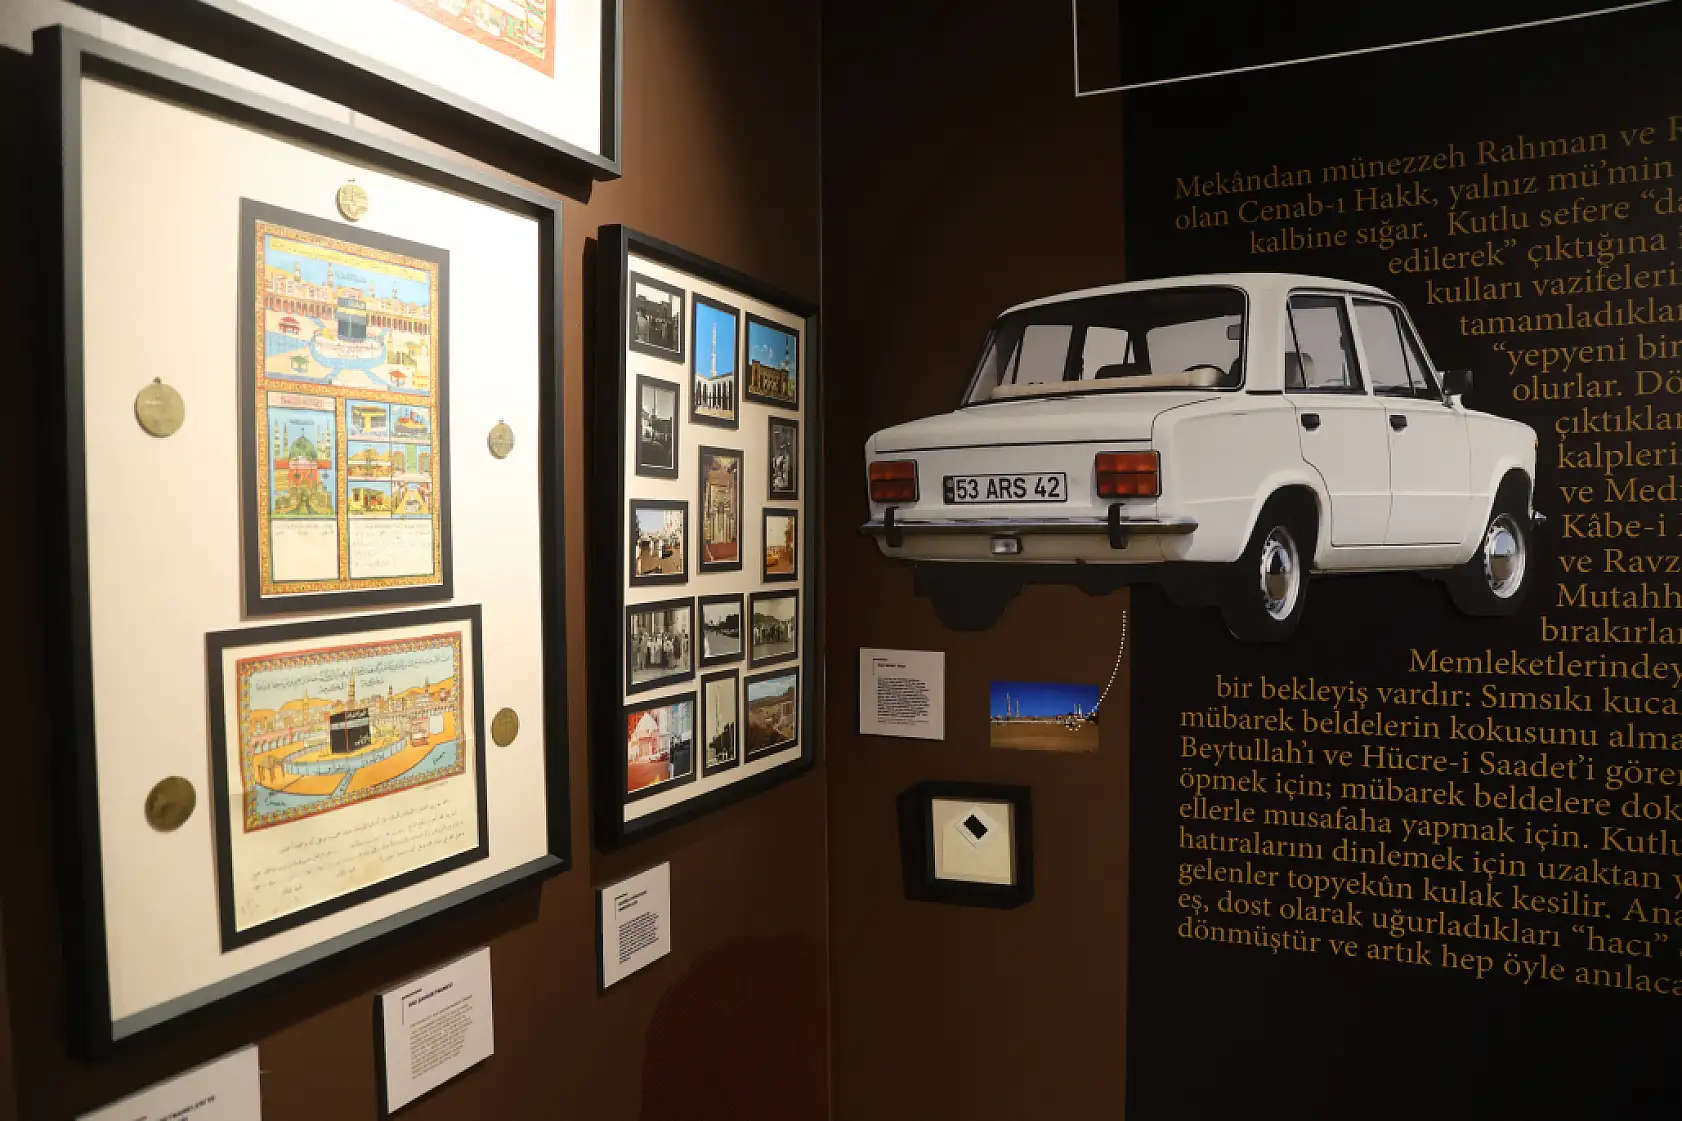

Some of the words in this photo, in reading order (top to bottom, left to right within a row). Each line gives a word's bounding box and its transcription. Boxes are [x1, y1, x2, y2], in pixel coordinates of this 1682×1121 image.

[1176, 165, 1311, 199] Mekândan
[1323, 144, 1465, 182] münezzeh
[1479, 134, 1607, 164] Rahman
[1620, 128, 1654, 146] ve
[1176, 206, 1228, 229] olan
[1239, 193, 1344, 222] Cenab-ı
[1354, 181, 1438, 211] Hakk,
[1449, 173, 1537, 209] yalnız
[1251, 227, 1347, 254] kalbine
[1356, 219, 1427, 250] sığar.
[1448, 206, 1529, 235] Kutlu
[1540, 198, 1630, 227] sefere
[1528, 232, 1666, 271] çıktığına
[1427, 276, 1522, 304] kulları
[1532, 262, 1682, 296] vazifeleri
[1637, 333, 1682, 360] bir
[1512, 372, 1622, 401] olurlar.
[1635, 370, 1682, 395] Dö
[1557, 440, 1682, 476] kalpleri
[957, 479, 979, 499] 53
[987, 477, 1027, 499] ARS
[1035, 476, 1060, 498] 42
[1559, 487, 1593, 504] ve
[1604, 475, 1682, 502] Med
[1561, 512, 1666, 538] Kâbe-i
[1558, 556, 1592, 572] ve
[1603, 549, 1680, 572] Ravz
[1556, 582, 1682, 608] Mutahh
[1216, 674, 1252, 698] bir
[1260, 676, 1368, 709] bekleyiş
[1376, 681, 1470, 707] vardır:
[1481, 684, 1592, 711] Sımsıkı
[1603, 686, 1679, 716] kuca
[1180, 705, 1294, 732] mübarek
[1303, 709, 1440, 739] beldelerin
[1450, 715, 1599, 746] kokusunu
[1322, 750, 1352, 767] ve
[1361, 745, 1470, 773] Hücre-i
[1179, 768, 1267, 796] öpmek
[1275, 773, 1331, 801] için;
[1340, 777, 1466, 806] mübarek
[1474, 782, 1610, 816] beldelere
[1621, 792, 1682, 821] dok
[1180, 799, 1256, 822] ellerle
[1263, 806, 1392, 833] musafaha
[1401, 817, 1515, 845] yapmak
[1525, 822, 1588, 852] için.
[1180, 825, 1323, 860] hatıralarını
[1332, 838, 1463, 871] dinlemek
[1473, 851, 1527, 881] için
[1538, 858, 1661, 889] uzaktan
[1178, 858, 1279, 886] gelenler
[1288, 869, 1413, 900] topyekûn
[1423, 877, 1503, 907] kulak
[1512, 885, 1610, 918] kesilir.
[1178, 893, 1208, 915] eş,
[1217, 890, 1272, 917] dost
[1280, 897, 1363, 927] olarak
[1372, 909, 1560, 947] uğurladıkları
[1178, 916, 1321, 954] dönmüştür
[1329, 939, 1358, 956] ve
[1367, 941, 1432, 966] artık
[1441, 943, 1494, 979] hep
[1504, 952, 1565, 985] öyle
